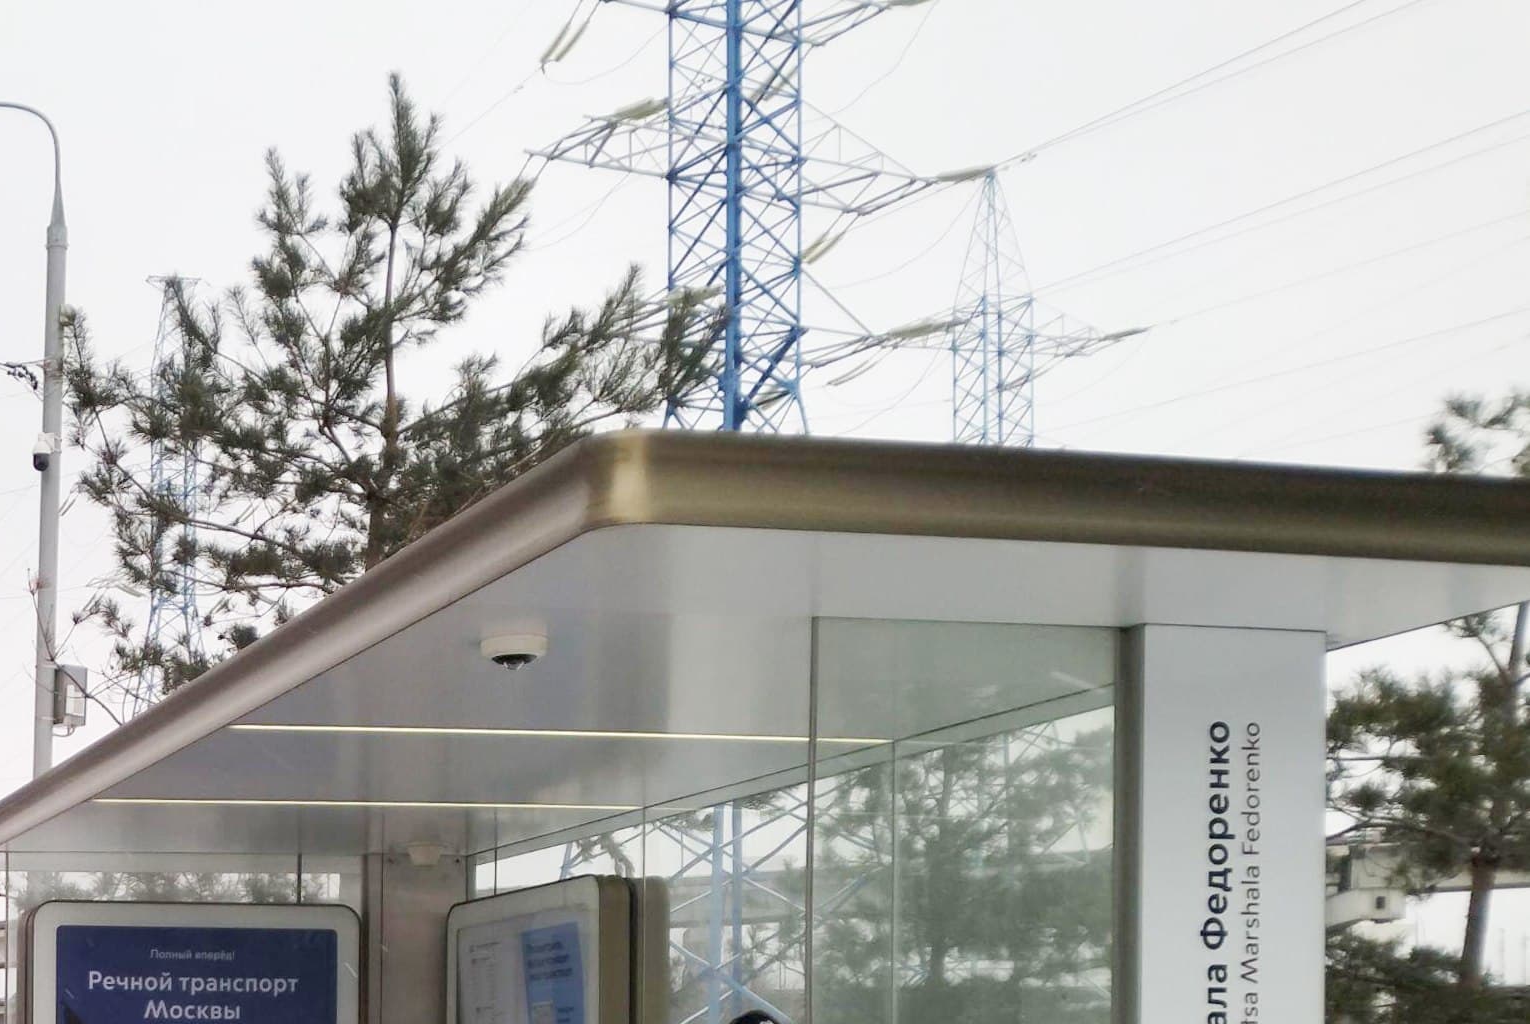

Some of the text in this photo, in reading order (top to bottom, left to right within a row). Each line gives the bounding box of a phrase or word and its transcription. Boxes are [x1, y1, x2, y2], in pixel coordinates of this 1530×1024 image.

[1240, 721, 1261, 856] Fedorenko
[1199, 720, 1236, 951] Федоренко
[150, 948, 192, 961] Полный
[1239, 864, 1261, 984] Marshala
[87, 970, 299, 997] Речной транспорт
[143, 999, 241, 1020] Москвы
